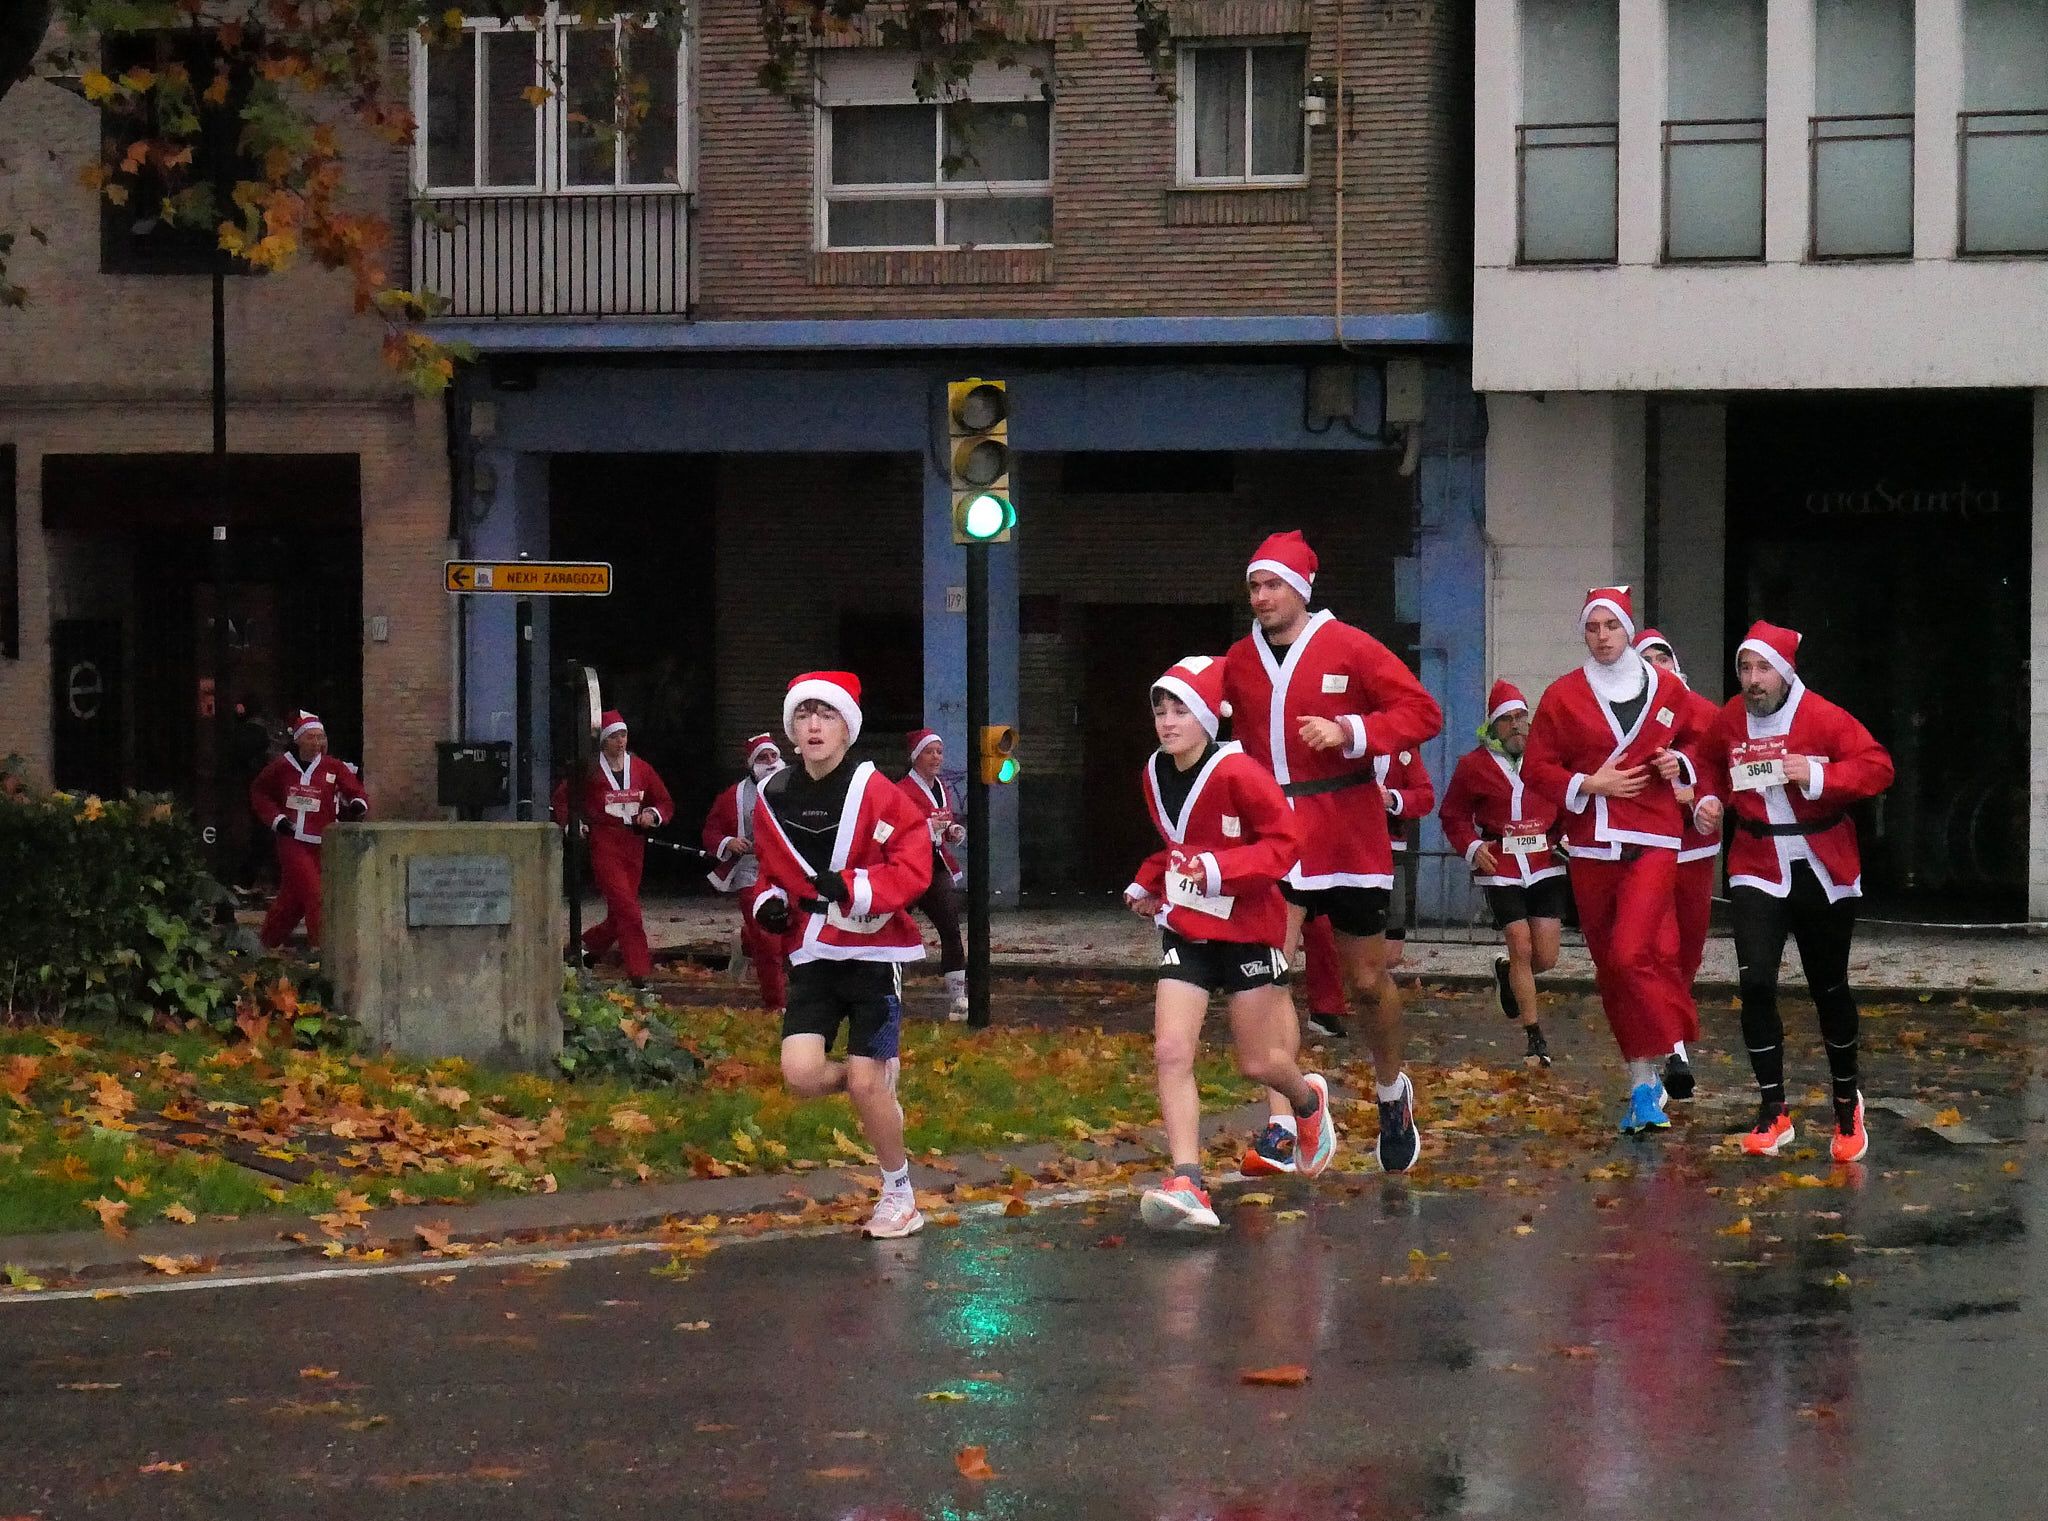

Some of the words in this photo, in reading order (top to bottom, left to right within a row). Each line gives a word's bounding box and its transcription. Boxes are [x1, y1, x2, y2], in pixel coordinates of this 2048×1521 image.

[507, 571, 538, 584] NEXH
[543, 572, 604, 585] ZARAGOZA
[69, 661, 104, 720] e
[1746, 761, 1773, 777] 3640
[202, 825, 217, 844] e
[1516, 835, 1537, 846] 1209
